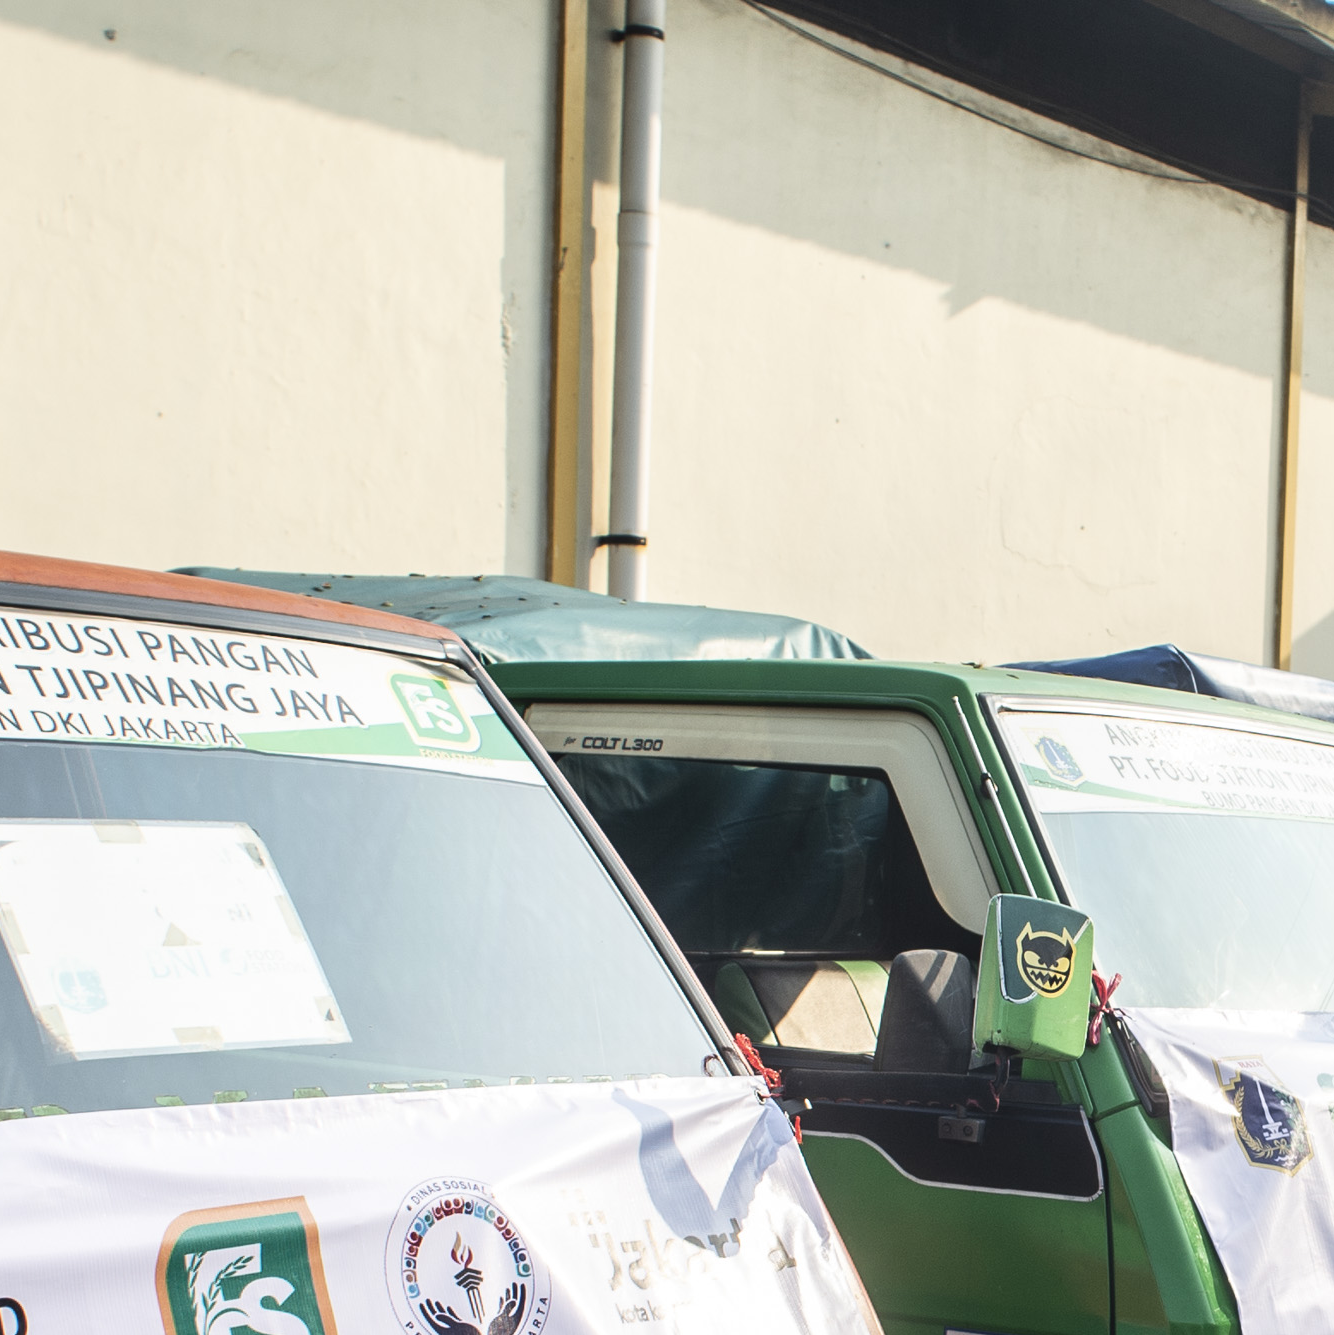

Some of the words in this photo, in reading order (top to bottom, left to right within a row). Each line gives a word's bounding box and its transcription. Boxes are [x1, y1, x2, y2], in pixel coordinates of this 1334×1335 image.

[143, 632, 319, 680] PANGAN
[16, 663, 258, 716] TJIPINANG
[273, 688, 366, 728] JAYA
[395, 681, 464, 735] FS
[36, 709, 94, 737] DKI
[103, 713, 245, 747] JAKARTA
[581, 736, 621, 750] COLT
[621, 738, 664, 752] L300
[1108, 754, 1149, 780] PT.
[410, 1182, 442, 1206] DINAS
[442, 1180, 488, 1196] SOSIAL
